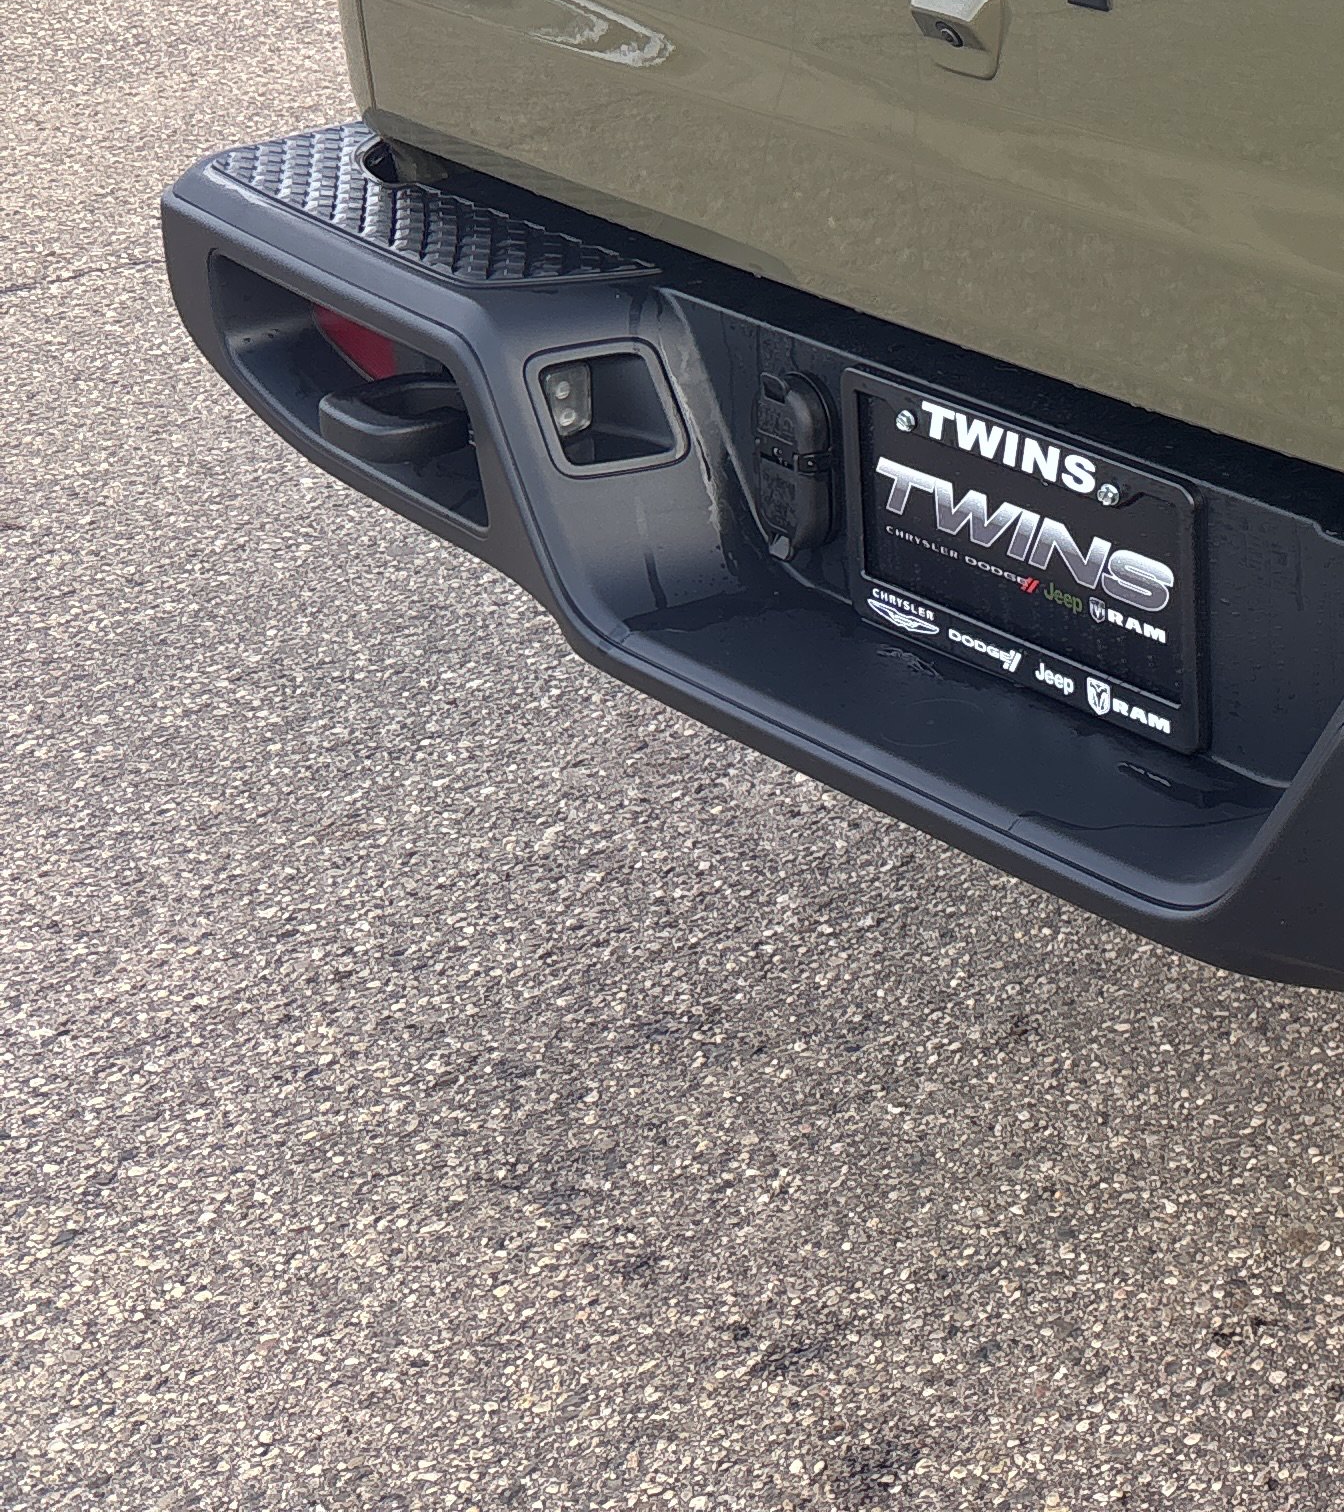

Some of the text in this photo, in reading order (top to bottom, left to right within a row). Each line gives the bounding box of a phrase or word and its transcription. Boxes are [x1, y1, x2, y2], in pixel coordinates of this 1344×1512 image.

[921, 400, 1097, 494] TWINS
[876, 456, 1174, 612] TWINS
[886, 525, 1167, 644] CHRYSLER DODGE Jeep RAM
[872, 588, 1171, 734] CHRYSLER DODGE Jeep RAM
